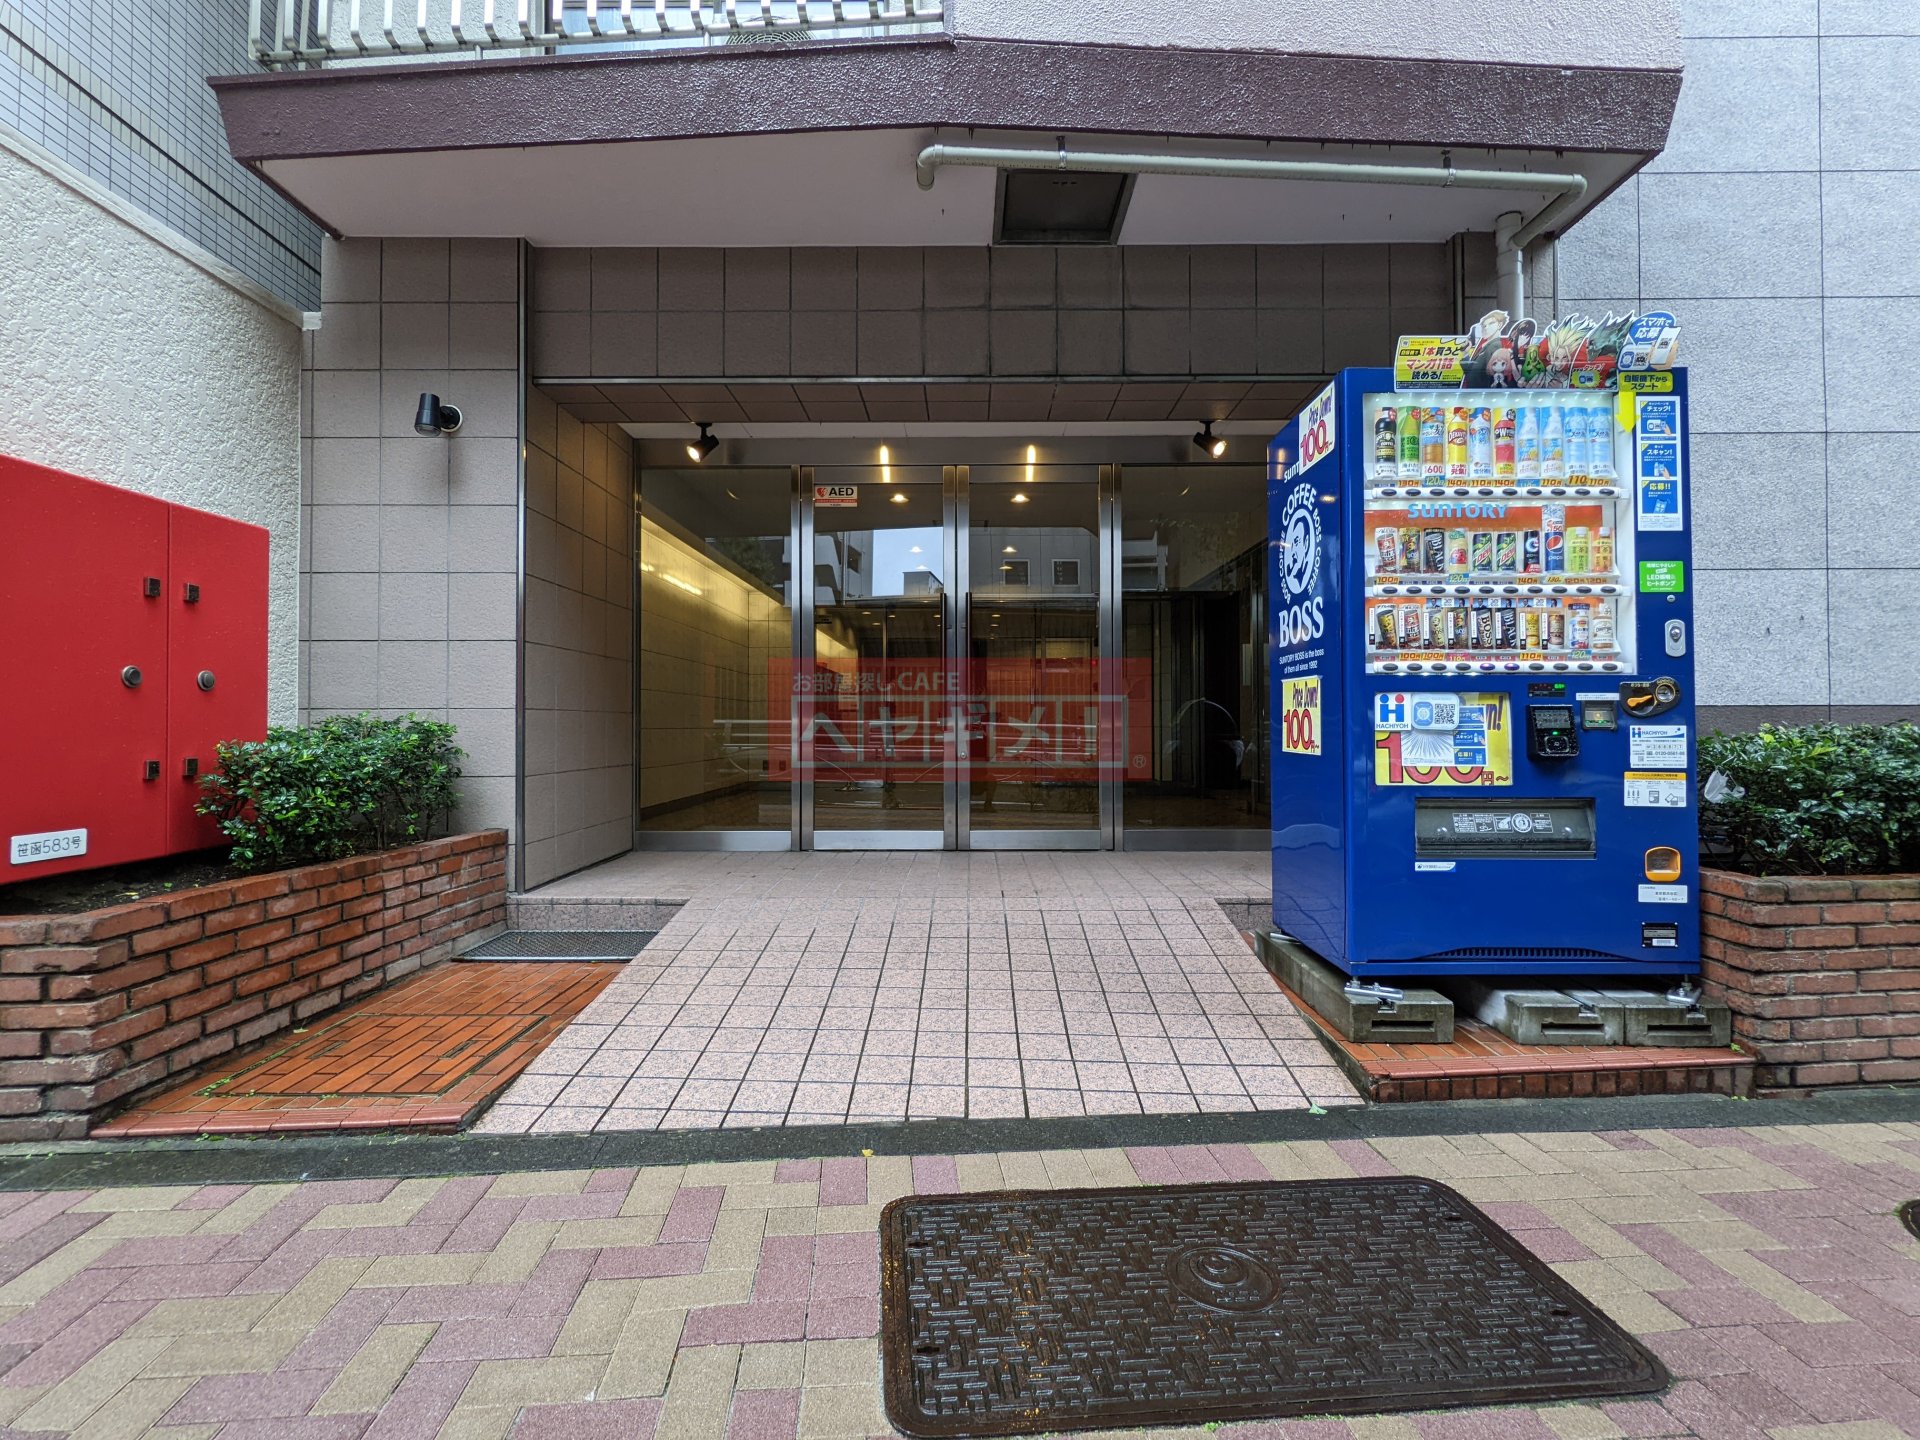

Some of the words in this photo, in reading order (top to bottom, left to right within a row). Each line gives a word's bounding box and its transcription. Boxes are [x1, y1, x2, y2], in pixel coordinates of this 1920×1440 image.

[829, 487, 854, 496] AED
[1282, 483, 1317, 526] COFFEE
[1408, 502, 1508, 519] SUNTORY
[1279, 596, 1324, 648] BOSS
[17, 836, 81, 857] 笹函583号
